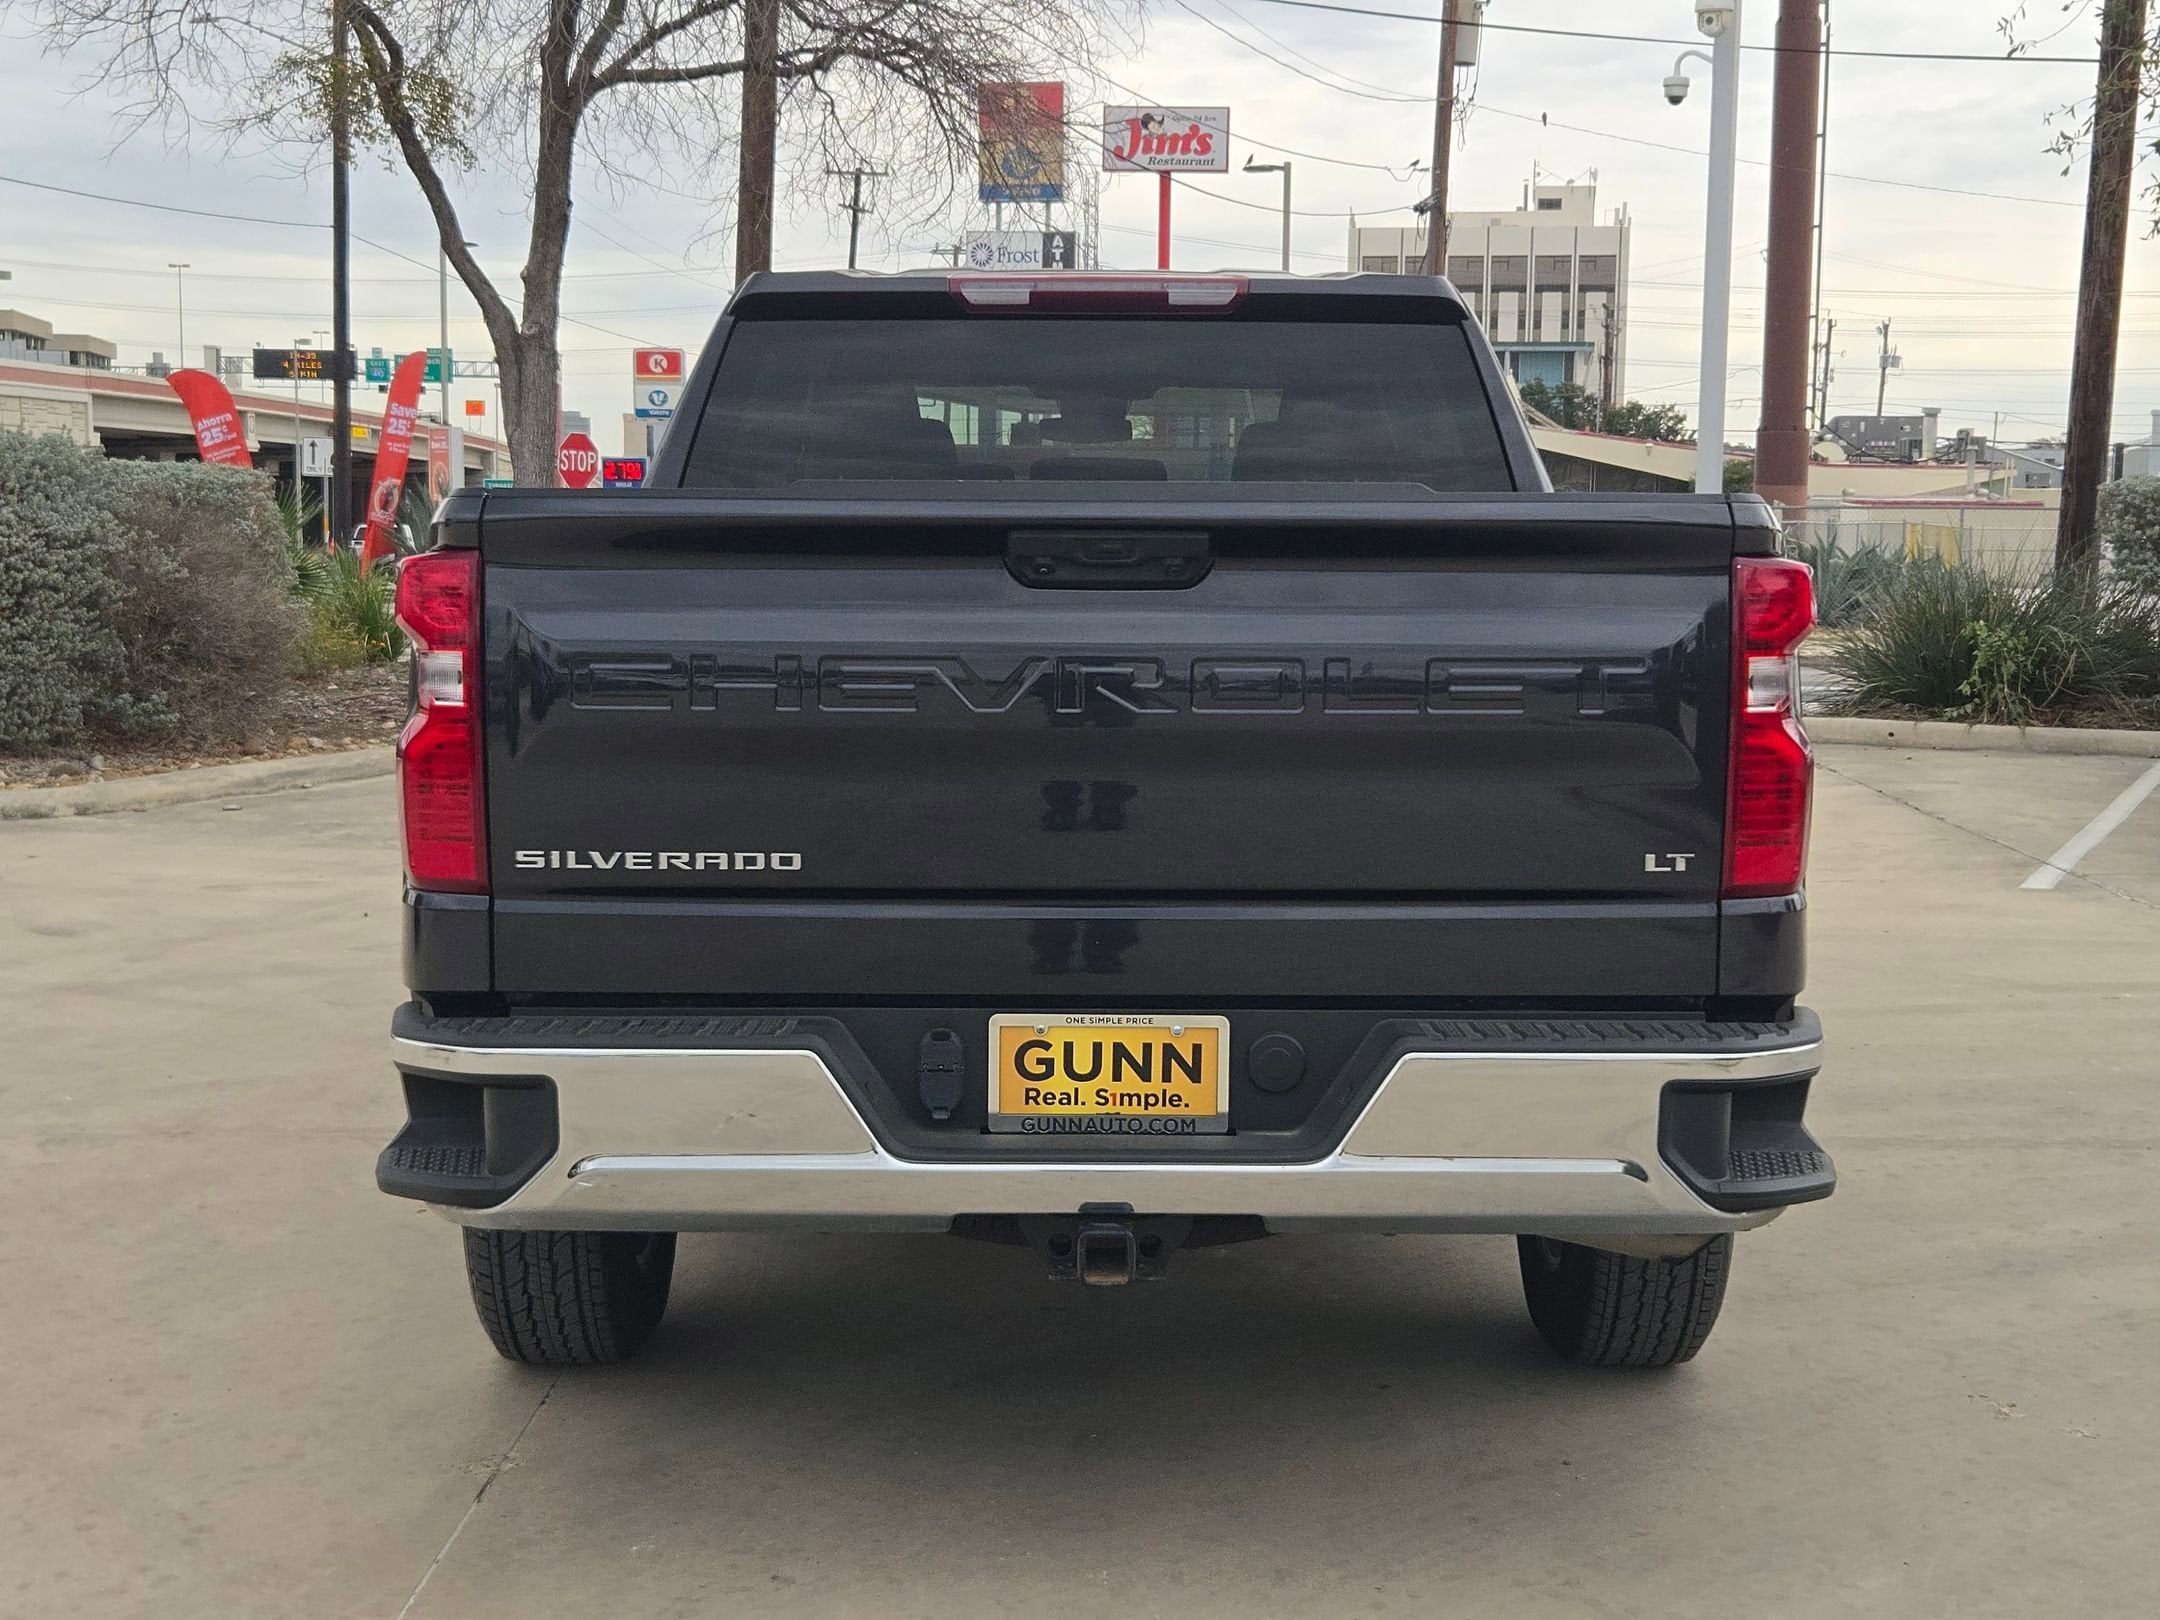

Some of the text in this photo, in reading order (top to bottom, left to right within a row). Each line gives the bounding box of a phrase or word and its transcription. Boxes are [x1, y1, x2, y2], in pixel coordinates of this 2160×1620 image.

[1114, 117, 1213, 162] Jim's
[1147, 156, 1215, 166] Restaurant
[997, 247, 1040, 263] Frost
[390, 403, 419, 418] Save
[198, 413, 232, 431] Ahorra
[560, 450, 596, 472] STOP
[570, 655, 1650, 714] CHEVROLET
[514, 851, 803, 870] SILVERADO
[1645, 853, 1695, 872] LT
[1014, 1039, 1202, 1084] GUNN
[1024, 1087, 1086, 1106] Real.
[1021, 1117, 1196, 1134] GUNNAUTO.COM
